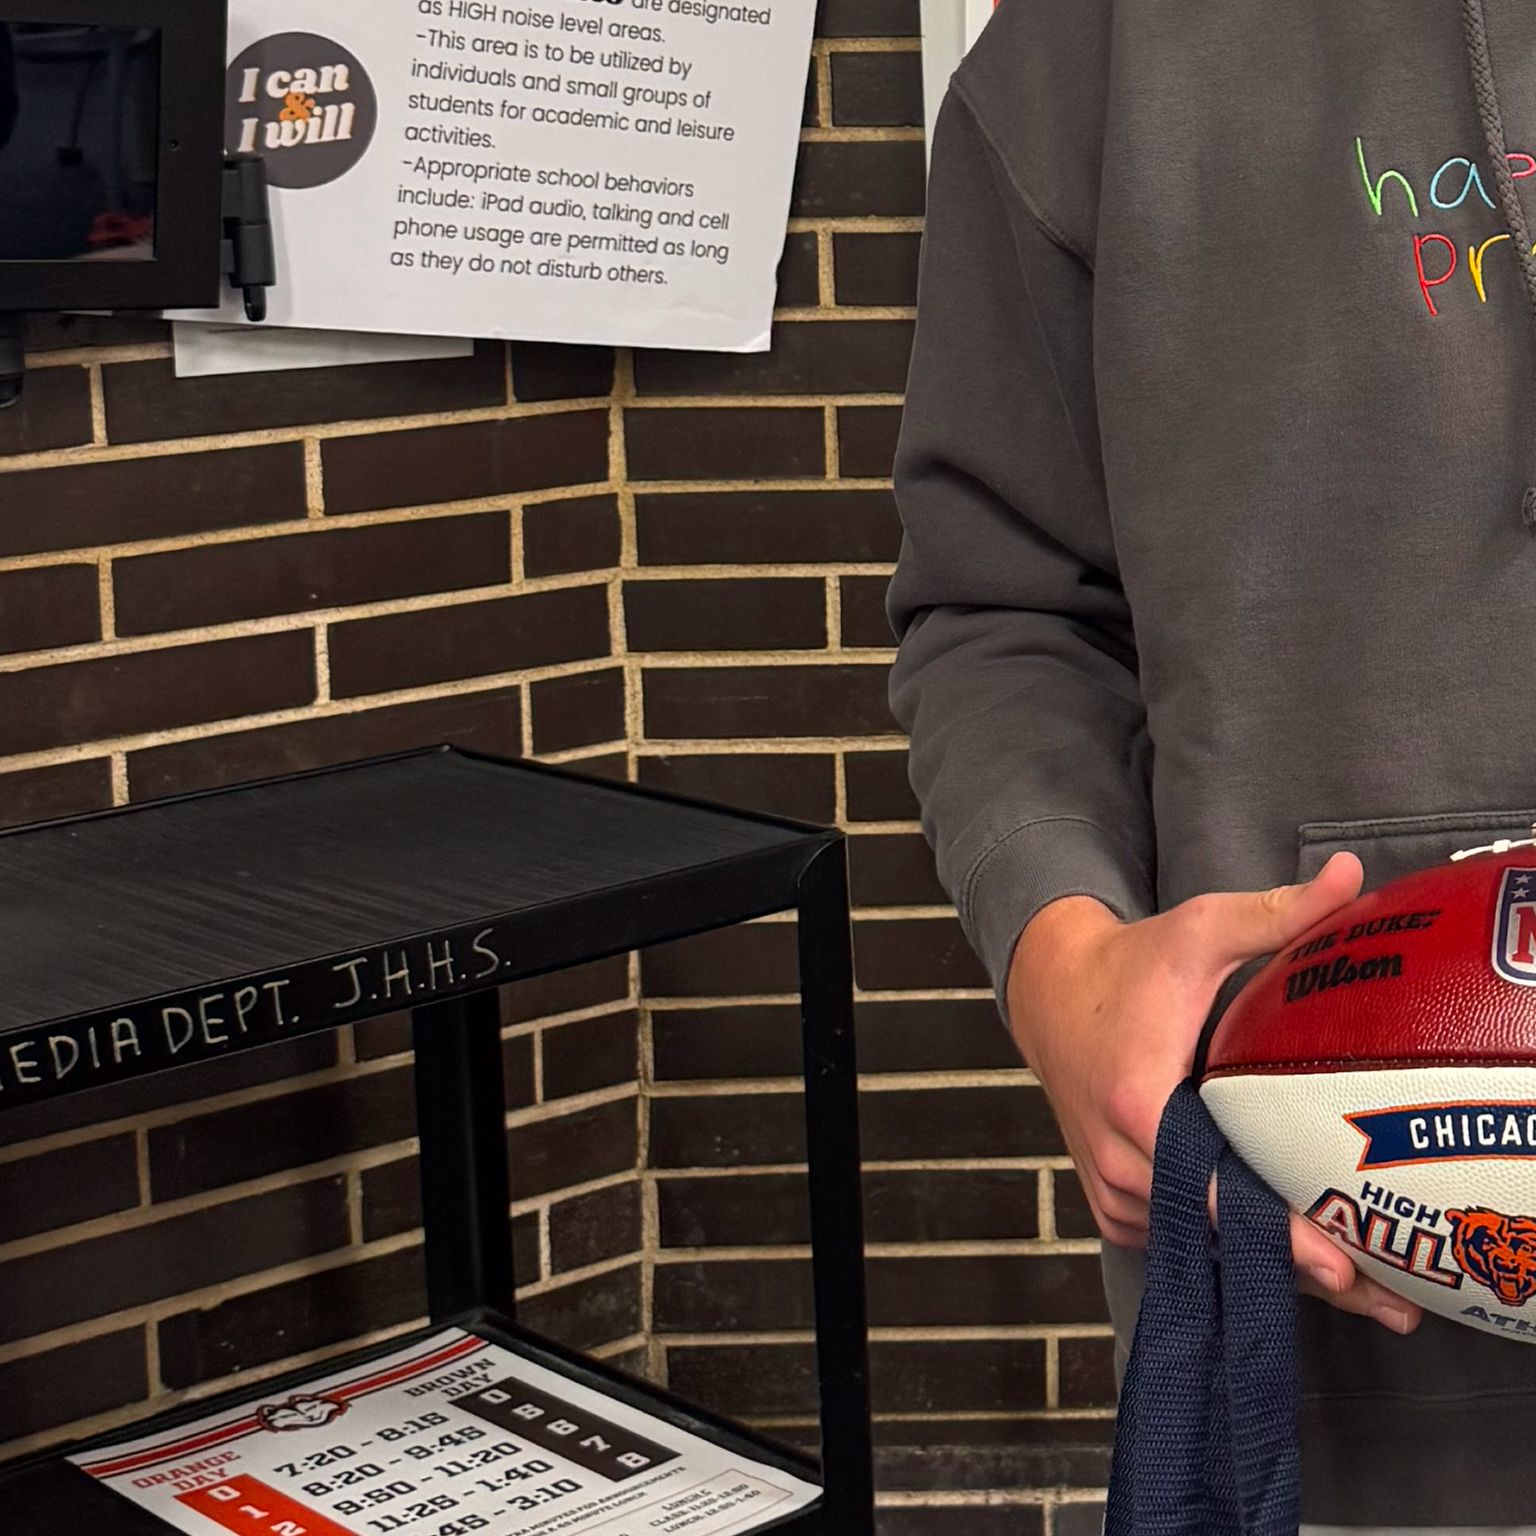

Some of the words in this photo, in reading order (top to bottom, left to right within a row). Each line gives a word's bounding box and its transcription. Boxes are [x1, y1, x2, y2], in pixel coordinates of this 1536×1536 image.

[418, 0, 443, 16] as
[448, 0, 497, 22] HIGH
[502, 7, 555, 29] noise
[559, 12, 603, 36] level
[608, 22, 665, 43] areas.
[238, 67, 260, 102] I
[265, 63, 349, 98] can
[278, 91, 316, 122] &
[408, 92, 494, 117] students
[500, 99, 527, 120] for
[531, 107, 630, 131] academic
[634, 117, 672, 135] and
[676, 118, 735, 141] leisure
[237, 117, 259, 152] I
[264, 102, 355, 149] will
[404, 124, 496, 148] activities.
[402, 156, 532, 184] -Appropriate
[536, 168, 600, 189] school
[604, 172, 694, 198] behaviors
[397, 184, 475, 209] include:
[481, 191, 524, 213] iPad
[528, 199, 586, 221] audio,
[592, 203, 653, 230] talking
[656, 209, 695, 227] and
[698, 212, 730, 230] cell
[1286, 954, 1403, 1003] Wilson
[0, 1017, 142, 1091] EDIA
[162, 979, 300, 1054] DEPT.
[332, 928, 511, 1008] J.H.H.S.
[1360, 1181, 1442, 1228] HIGH
[1303, 1187, 1464, 1290] ALL
[403, 1358, 497, 1397] BROWN
[441, 1373, 494, 1397] DAY
[480, 1388, 512, 1404] 0
[273, 1445, 358, 1477] 7:20
[376, 1412, 450, 1441] 8:15
[546, 1419, 580, 1436] 6
[579, 1435, 611, 1452] 7
[131, 1450, 242, 1489] ORANGE
[171, 1468, 230, 1491] DAY
[302, 1463, 386, 1496] 8:20
[403, 1426, 487, 1460] 9:45
[333, 1480, 418, 1516] 9:50
[433, 1442, 523, 1477] 11:20
[616, 1452, 651, 1468] 8
[207, 1485, 241, 1502] 0
[239, 1505, 270, 1519] 1
[367, 1494, 460, 1533] 11:25
[475, 1459, 555, 1492] 1:40
[506, 1478, 584, 1510] 3:10
[270, 1520, 307, 1536] 2
